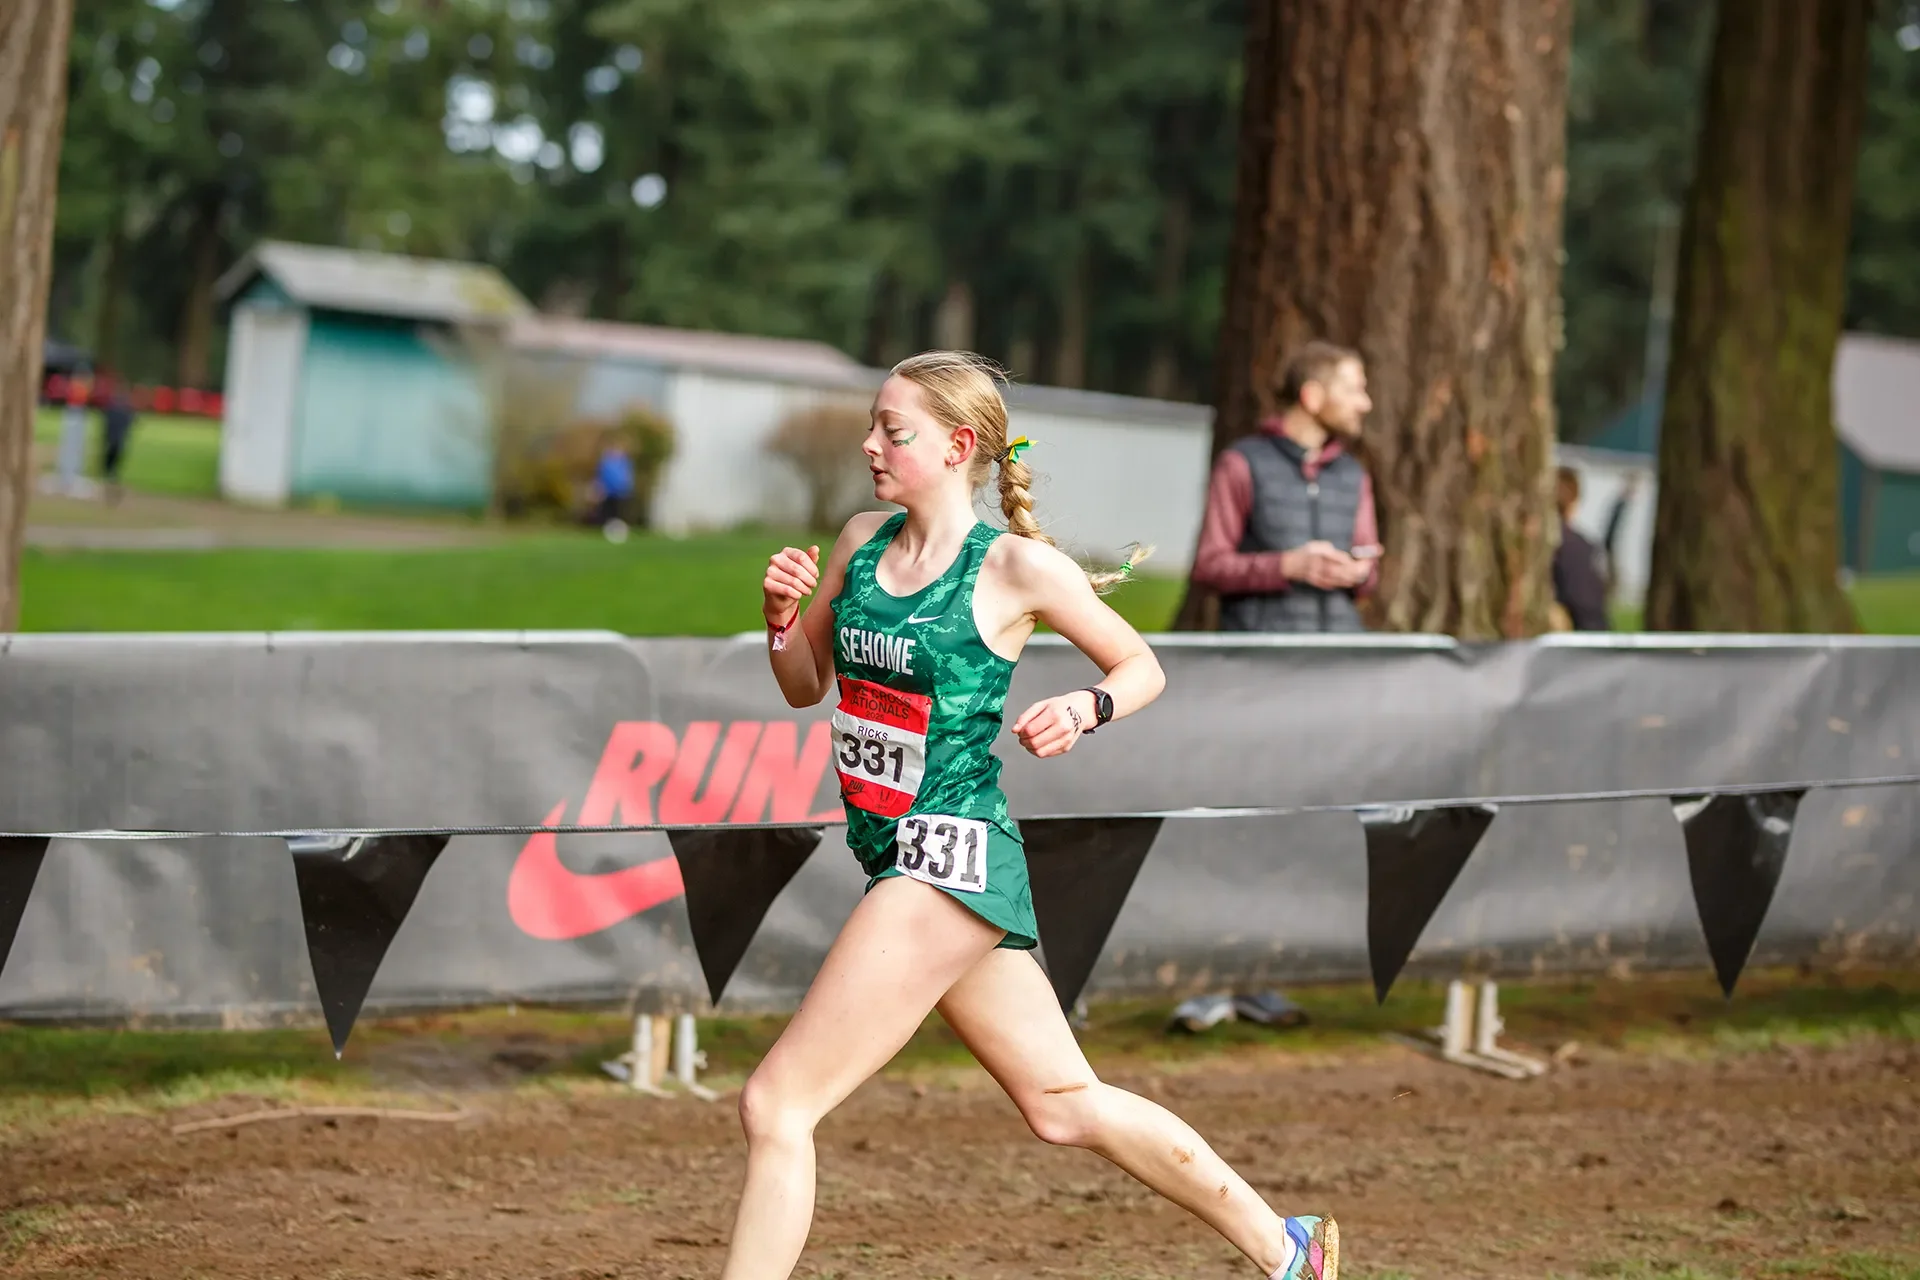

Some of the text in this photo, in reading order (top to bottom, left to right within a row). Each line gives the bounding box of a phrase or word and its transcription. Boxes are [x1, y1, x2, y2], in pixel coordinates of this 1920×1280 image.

[840, 627, 916, 676] SEHOME
[857, 725, 888, 741] RICKS
[577, 720, 834, 828] RUN
[840, 733, 904, 783] 331
[848, 780, 865, 792] RUN
[903, 818, 981, 884] 331
